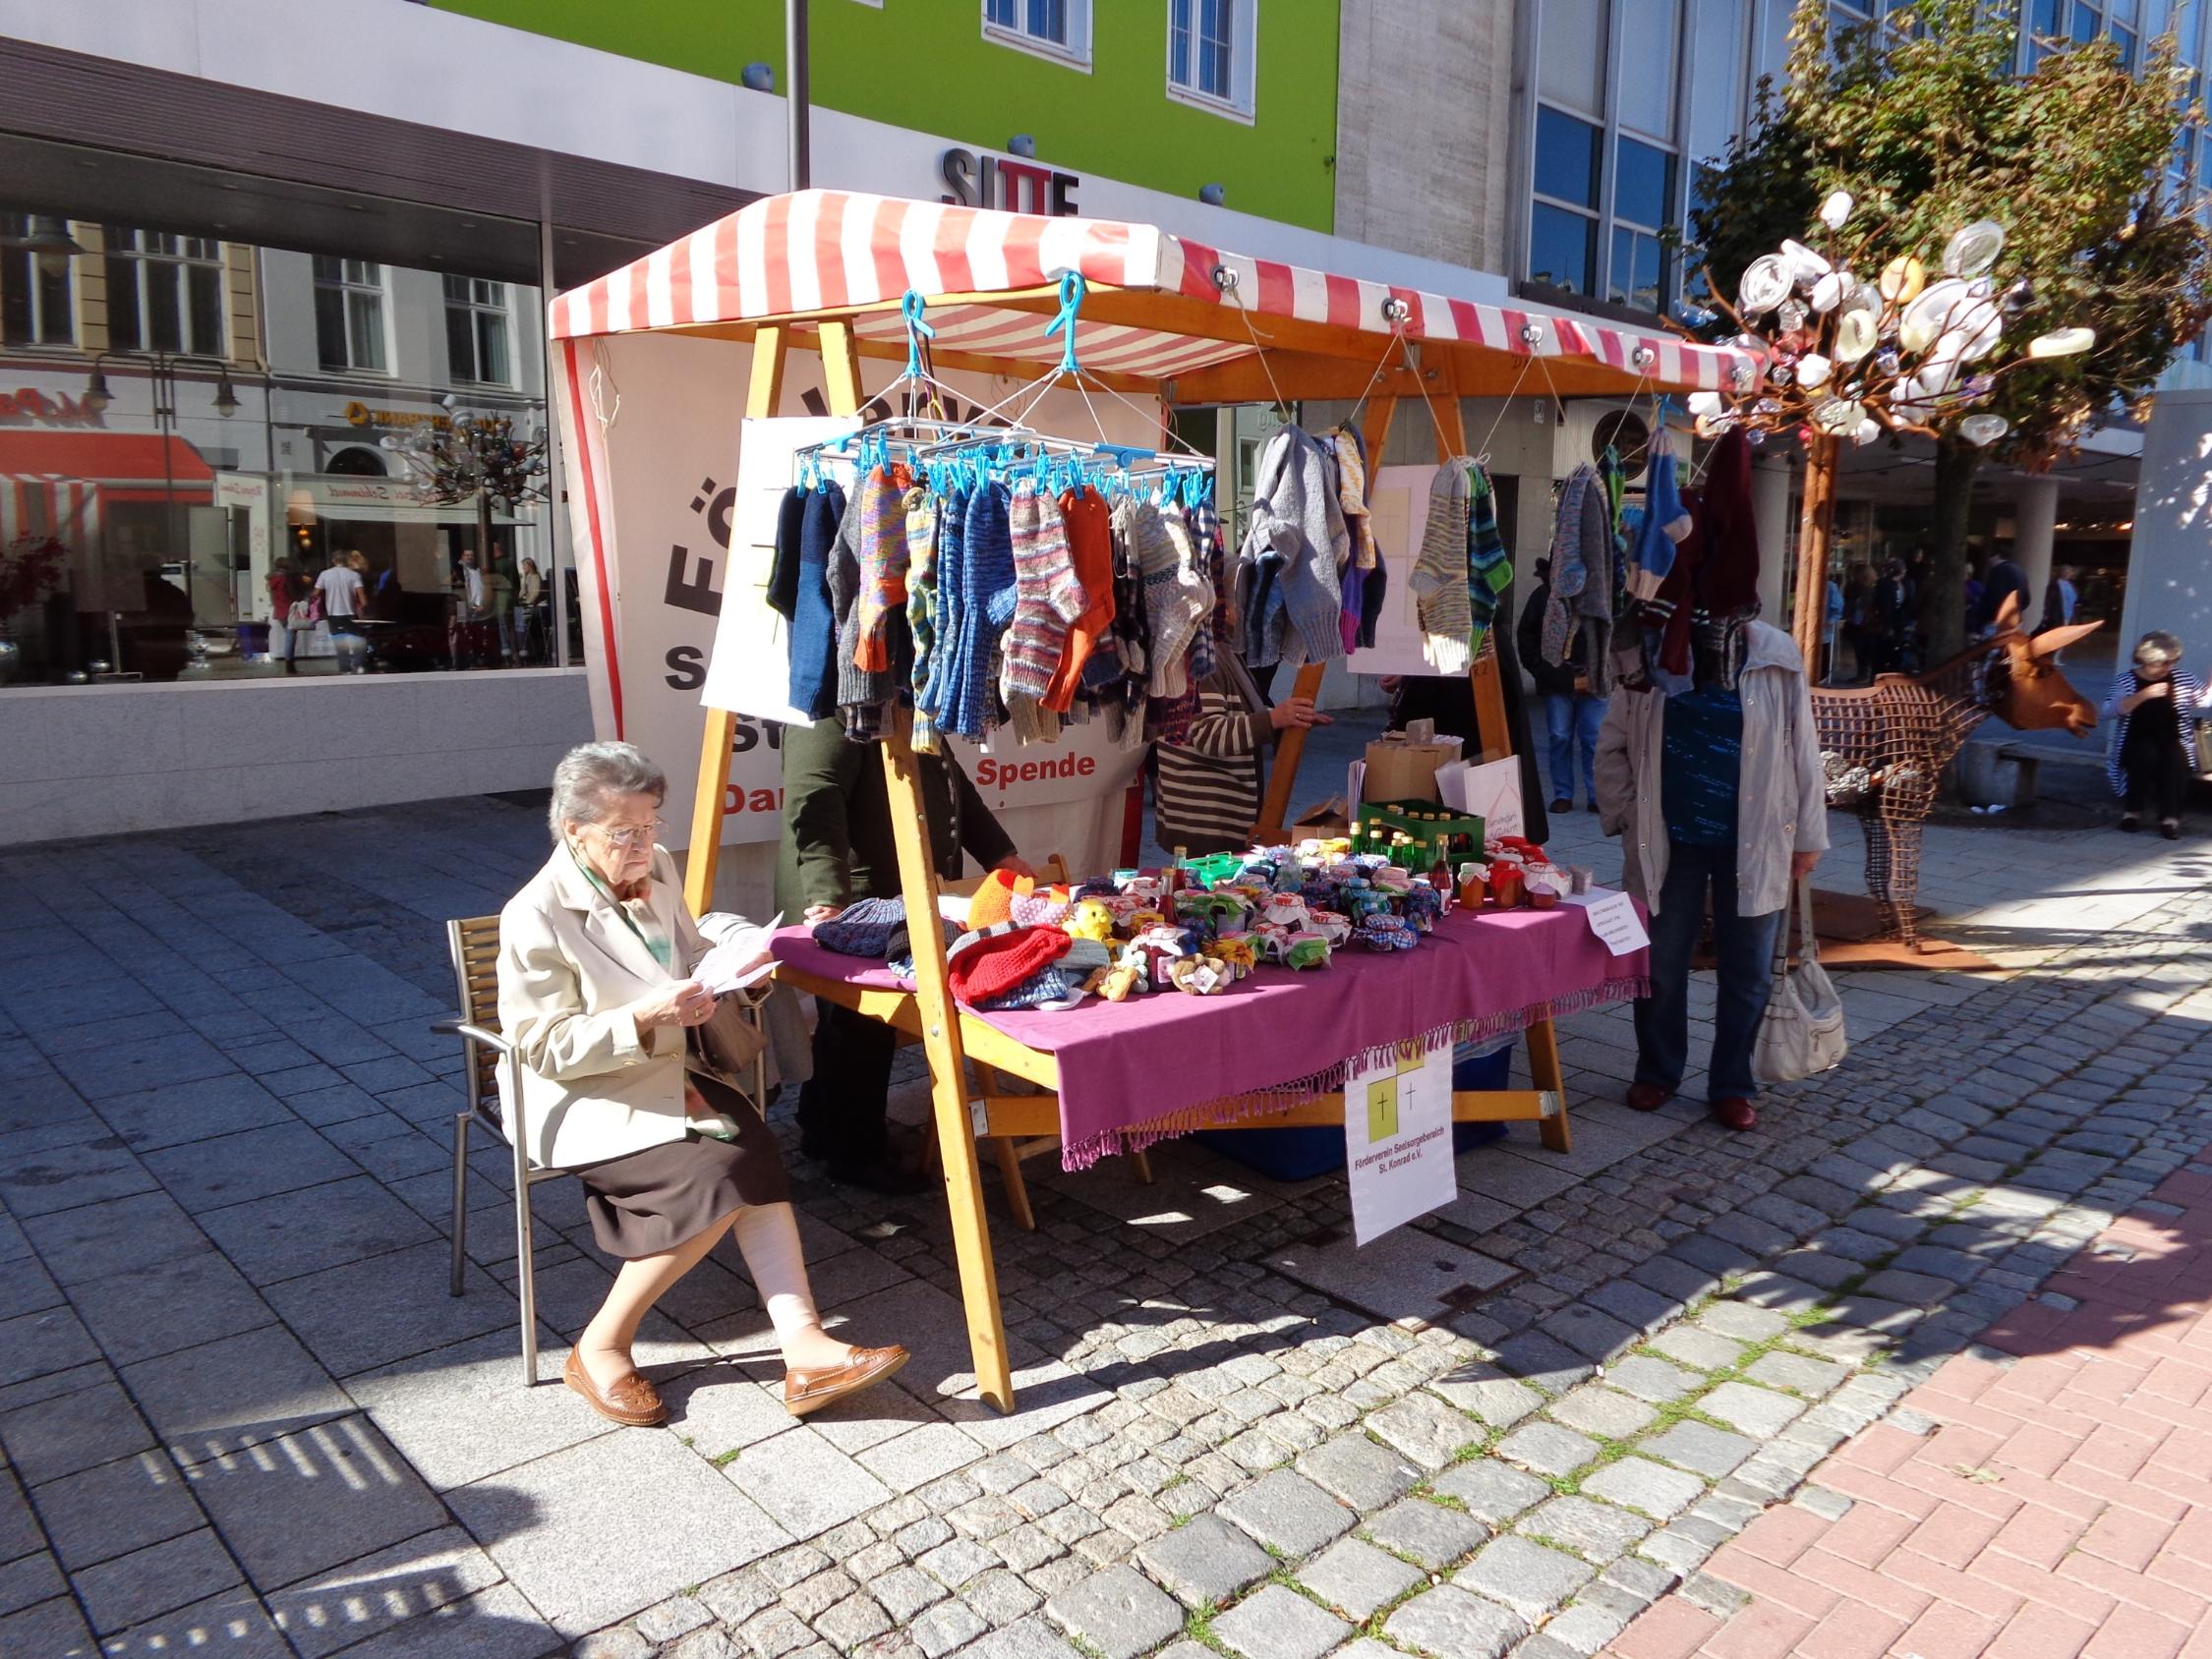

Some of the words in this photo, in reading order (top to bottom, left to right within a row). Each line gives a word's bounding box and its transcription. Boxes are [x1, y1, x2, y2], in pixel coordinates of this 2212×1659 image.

[942, 148, 1079, 216] SITTE
[975, 752, 1095, 790] Spende
[1355, 1148, 1393, 1171] Förderverein
[1394, 1126, 1445, 1154] Seelsorgebereich
[1389, 1153, 1411, 1171] Konrad
